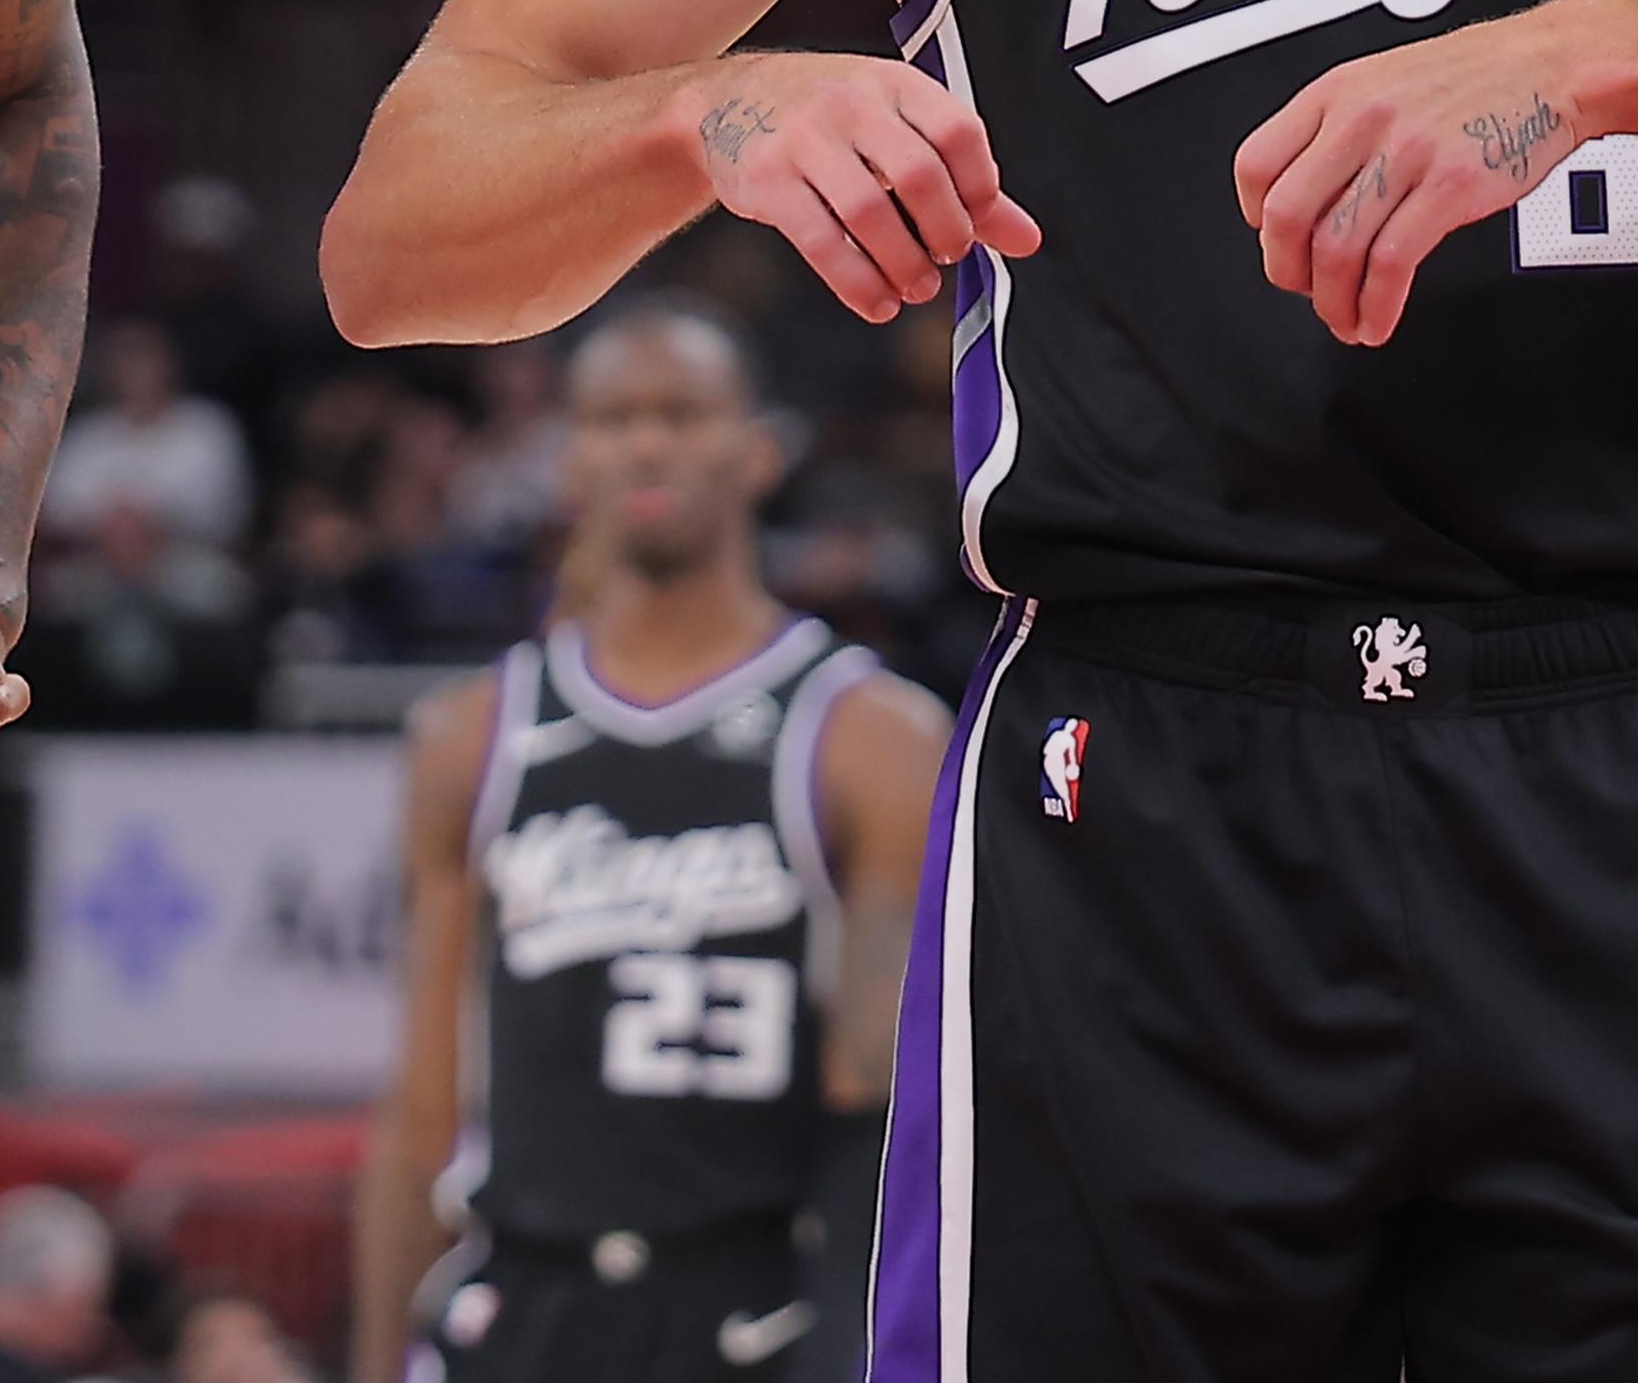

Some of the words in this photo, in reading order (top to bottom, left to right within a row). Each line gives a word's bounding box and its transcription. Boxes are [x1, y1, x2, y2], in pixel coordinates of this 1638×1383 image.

[1463, 92, 1561, 181] Elijah
[1043, 796, 1064, 817] NBA
[485, 802, 805, 979] Kings
[602, 952, 798, 1102] 23
